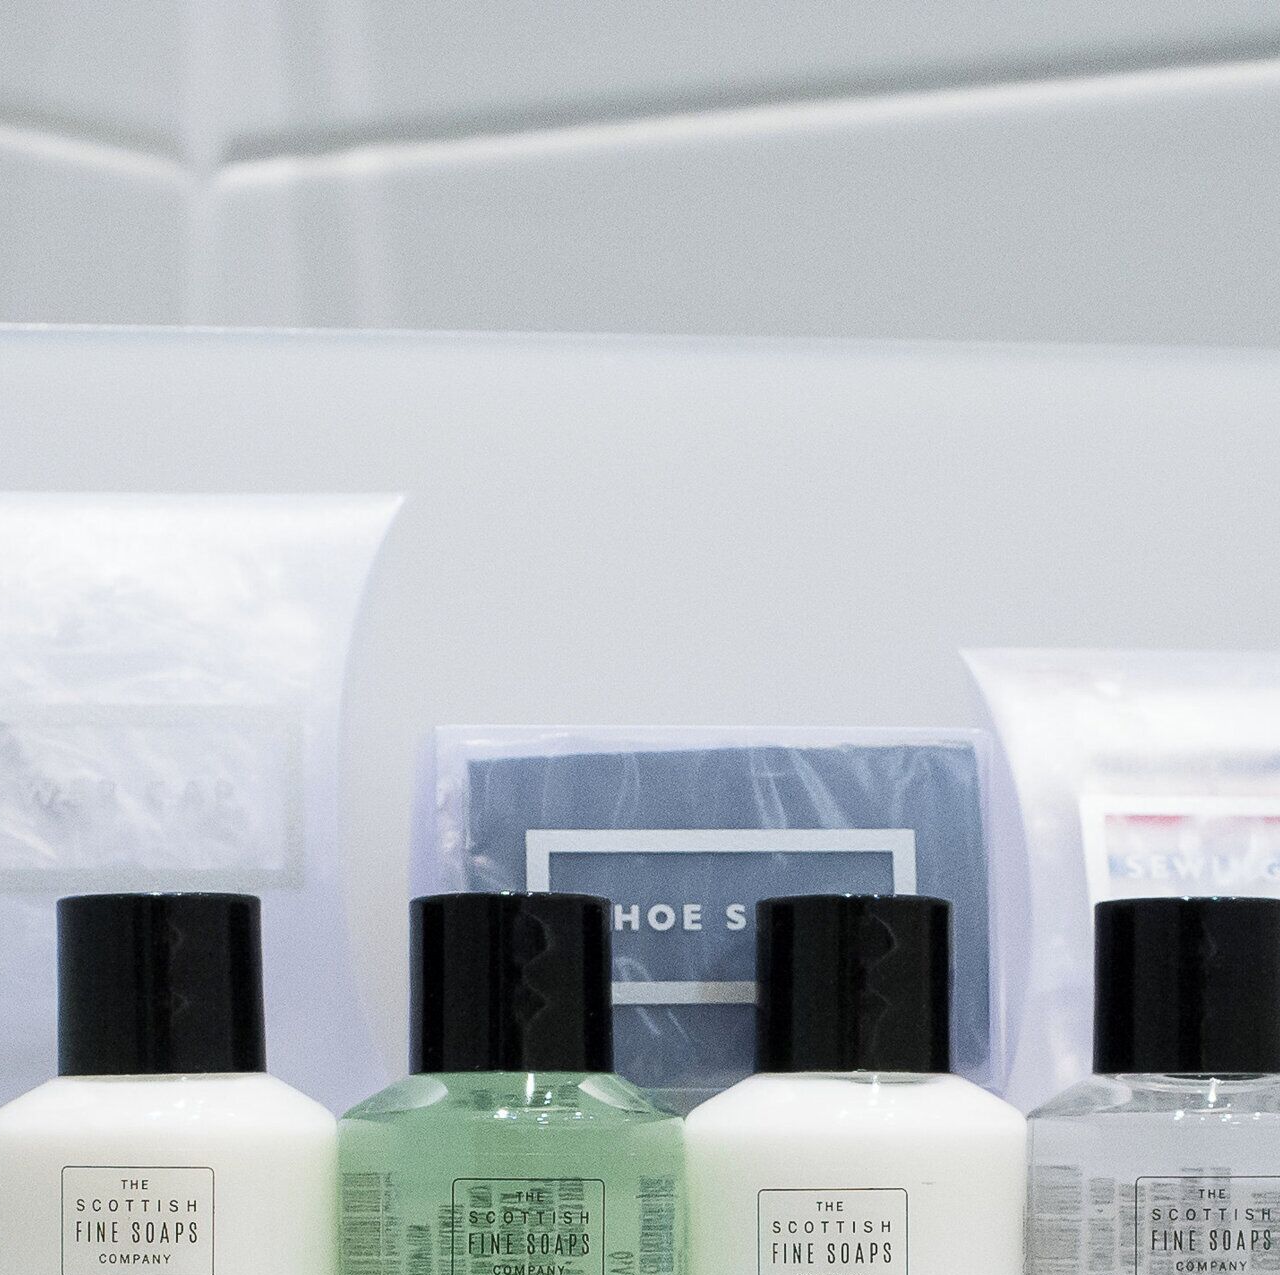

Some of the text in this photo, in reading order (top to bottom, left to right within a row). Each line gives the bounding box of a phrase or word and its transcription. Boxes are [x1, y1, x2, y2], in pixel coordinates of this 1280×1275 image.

[614, 903, 703, 931] HOE
[120, 1179, 150, 1191] THE
[515, 1191, 545, 1203] THE
[1198, 1188, 1227, 1199] THE
[76, 1199, 198, 1213] SCOTTISH
[816, 1201, 844, 1212] THE
[468, 1211, 590, 1225] SCOTTISH
[1151, 1208, 1272, 1222] SCOTTISH
[75, 1221, 199, 1245] FINE SOAPS
[772, 1220, 892, 1235] SCOTTISH
[468, 1232, 591, 1256] FINE SOAPS
[1151, 1229, 1272, 1251] FINE SOAPS
[98, 1253, 172, 1265] COMPANY
[771, 1242, 893, 1265] FINE SOAPS
[1175, 1260, 1247, 1272] COMPANY
